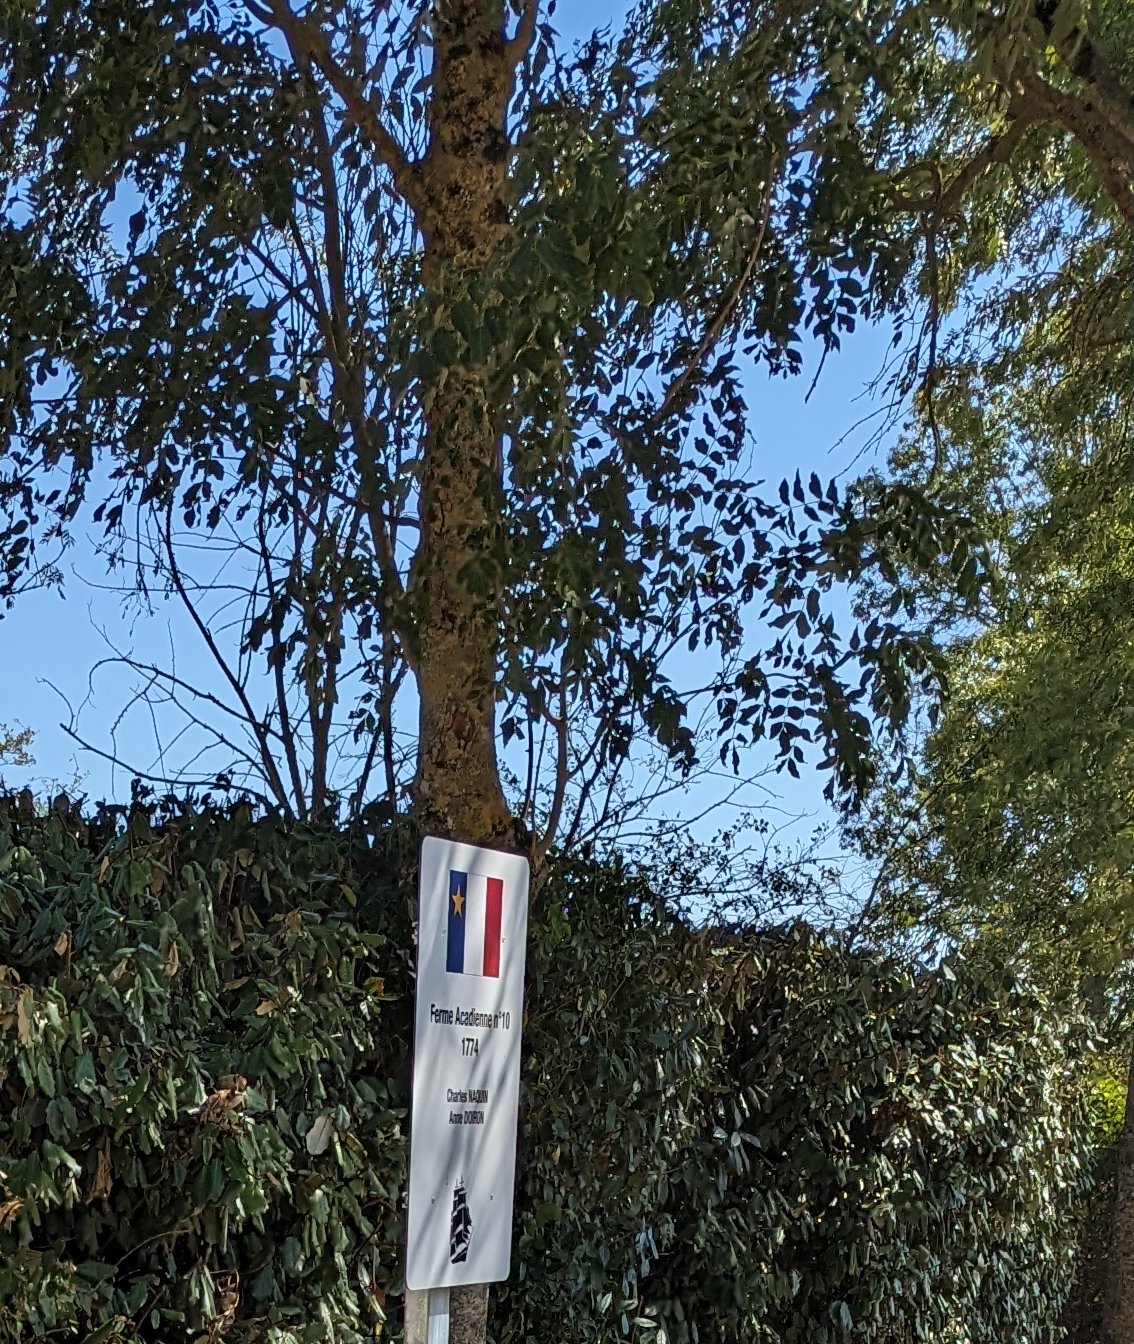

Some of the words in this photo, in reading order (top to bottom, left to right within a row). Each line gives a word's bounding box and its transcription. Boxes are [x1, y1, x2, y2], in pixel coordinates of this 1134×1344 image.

[431, 1004, 453, 1025] Ferme
[455, 1006, 492, 1028] Acadienne
[462, 1037, 478, 1057] 1774
